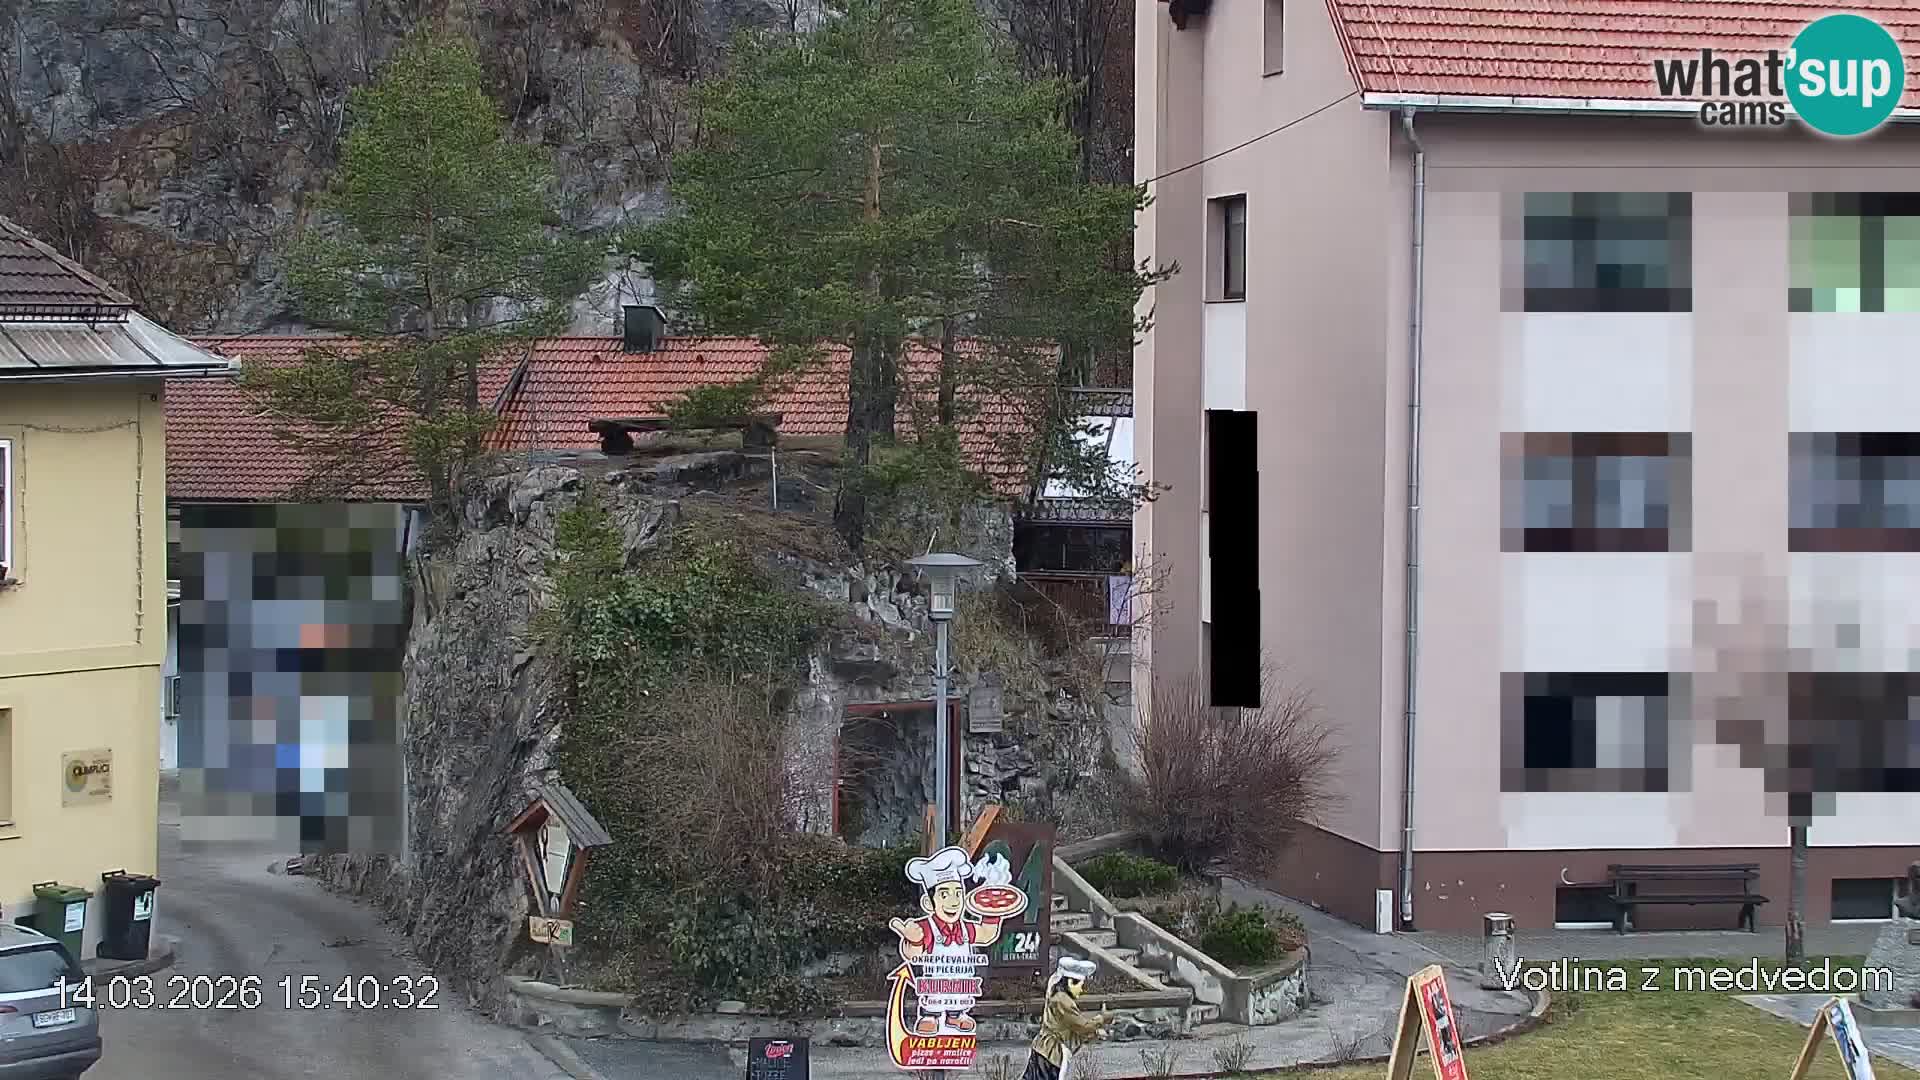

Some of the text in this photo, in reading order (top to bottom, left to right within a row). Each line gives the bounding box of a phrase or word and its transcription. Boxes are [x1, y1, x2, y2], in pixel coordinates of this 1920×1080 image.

[925, 965, 974, 974] IN PICERIJA
[909, 1037, 976, 1049] VABLJENI
